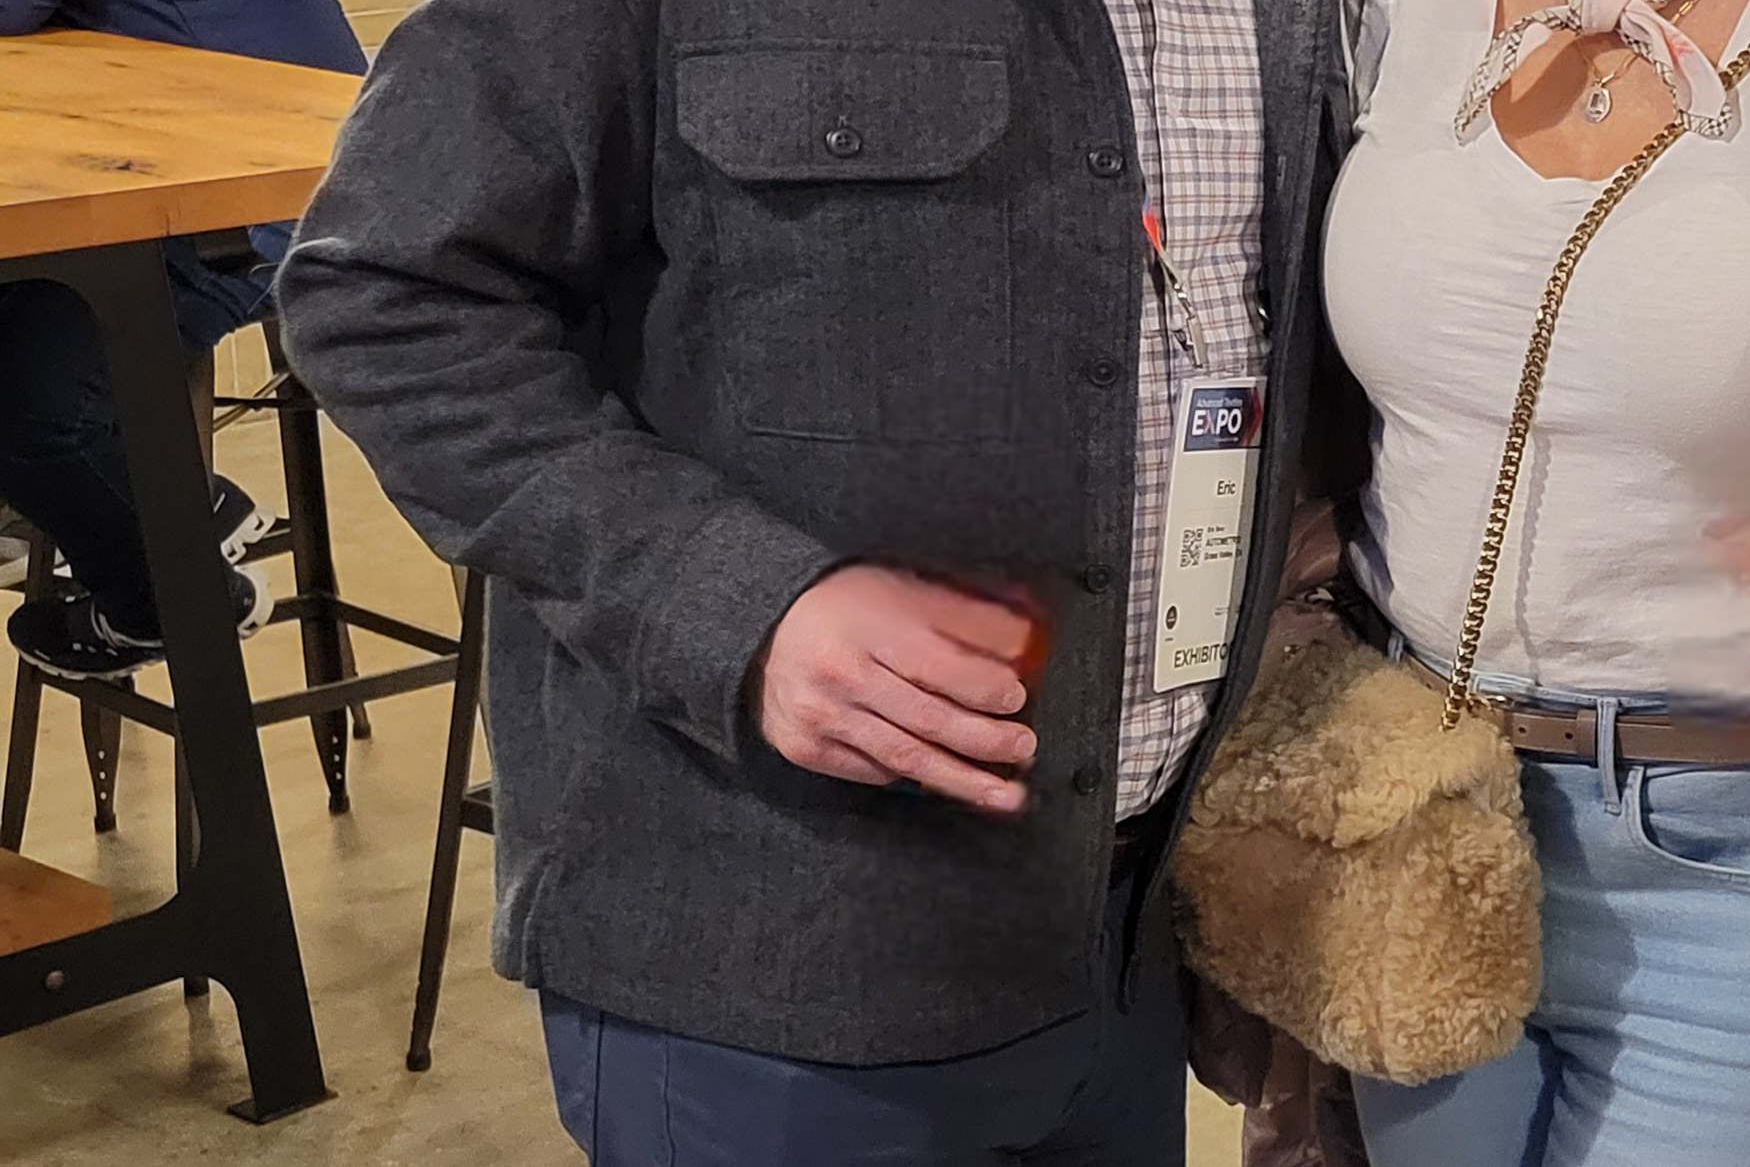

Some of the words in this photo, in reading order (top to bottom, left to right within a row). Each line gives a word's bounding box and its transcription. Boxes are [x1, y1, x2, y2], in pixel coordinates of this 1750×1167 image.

[1191, 408, 1243, 436] EXPO
[1217, 479, 1237, 496] Eric
[1173, 642, 1229, 669] EXHIBITO
